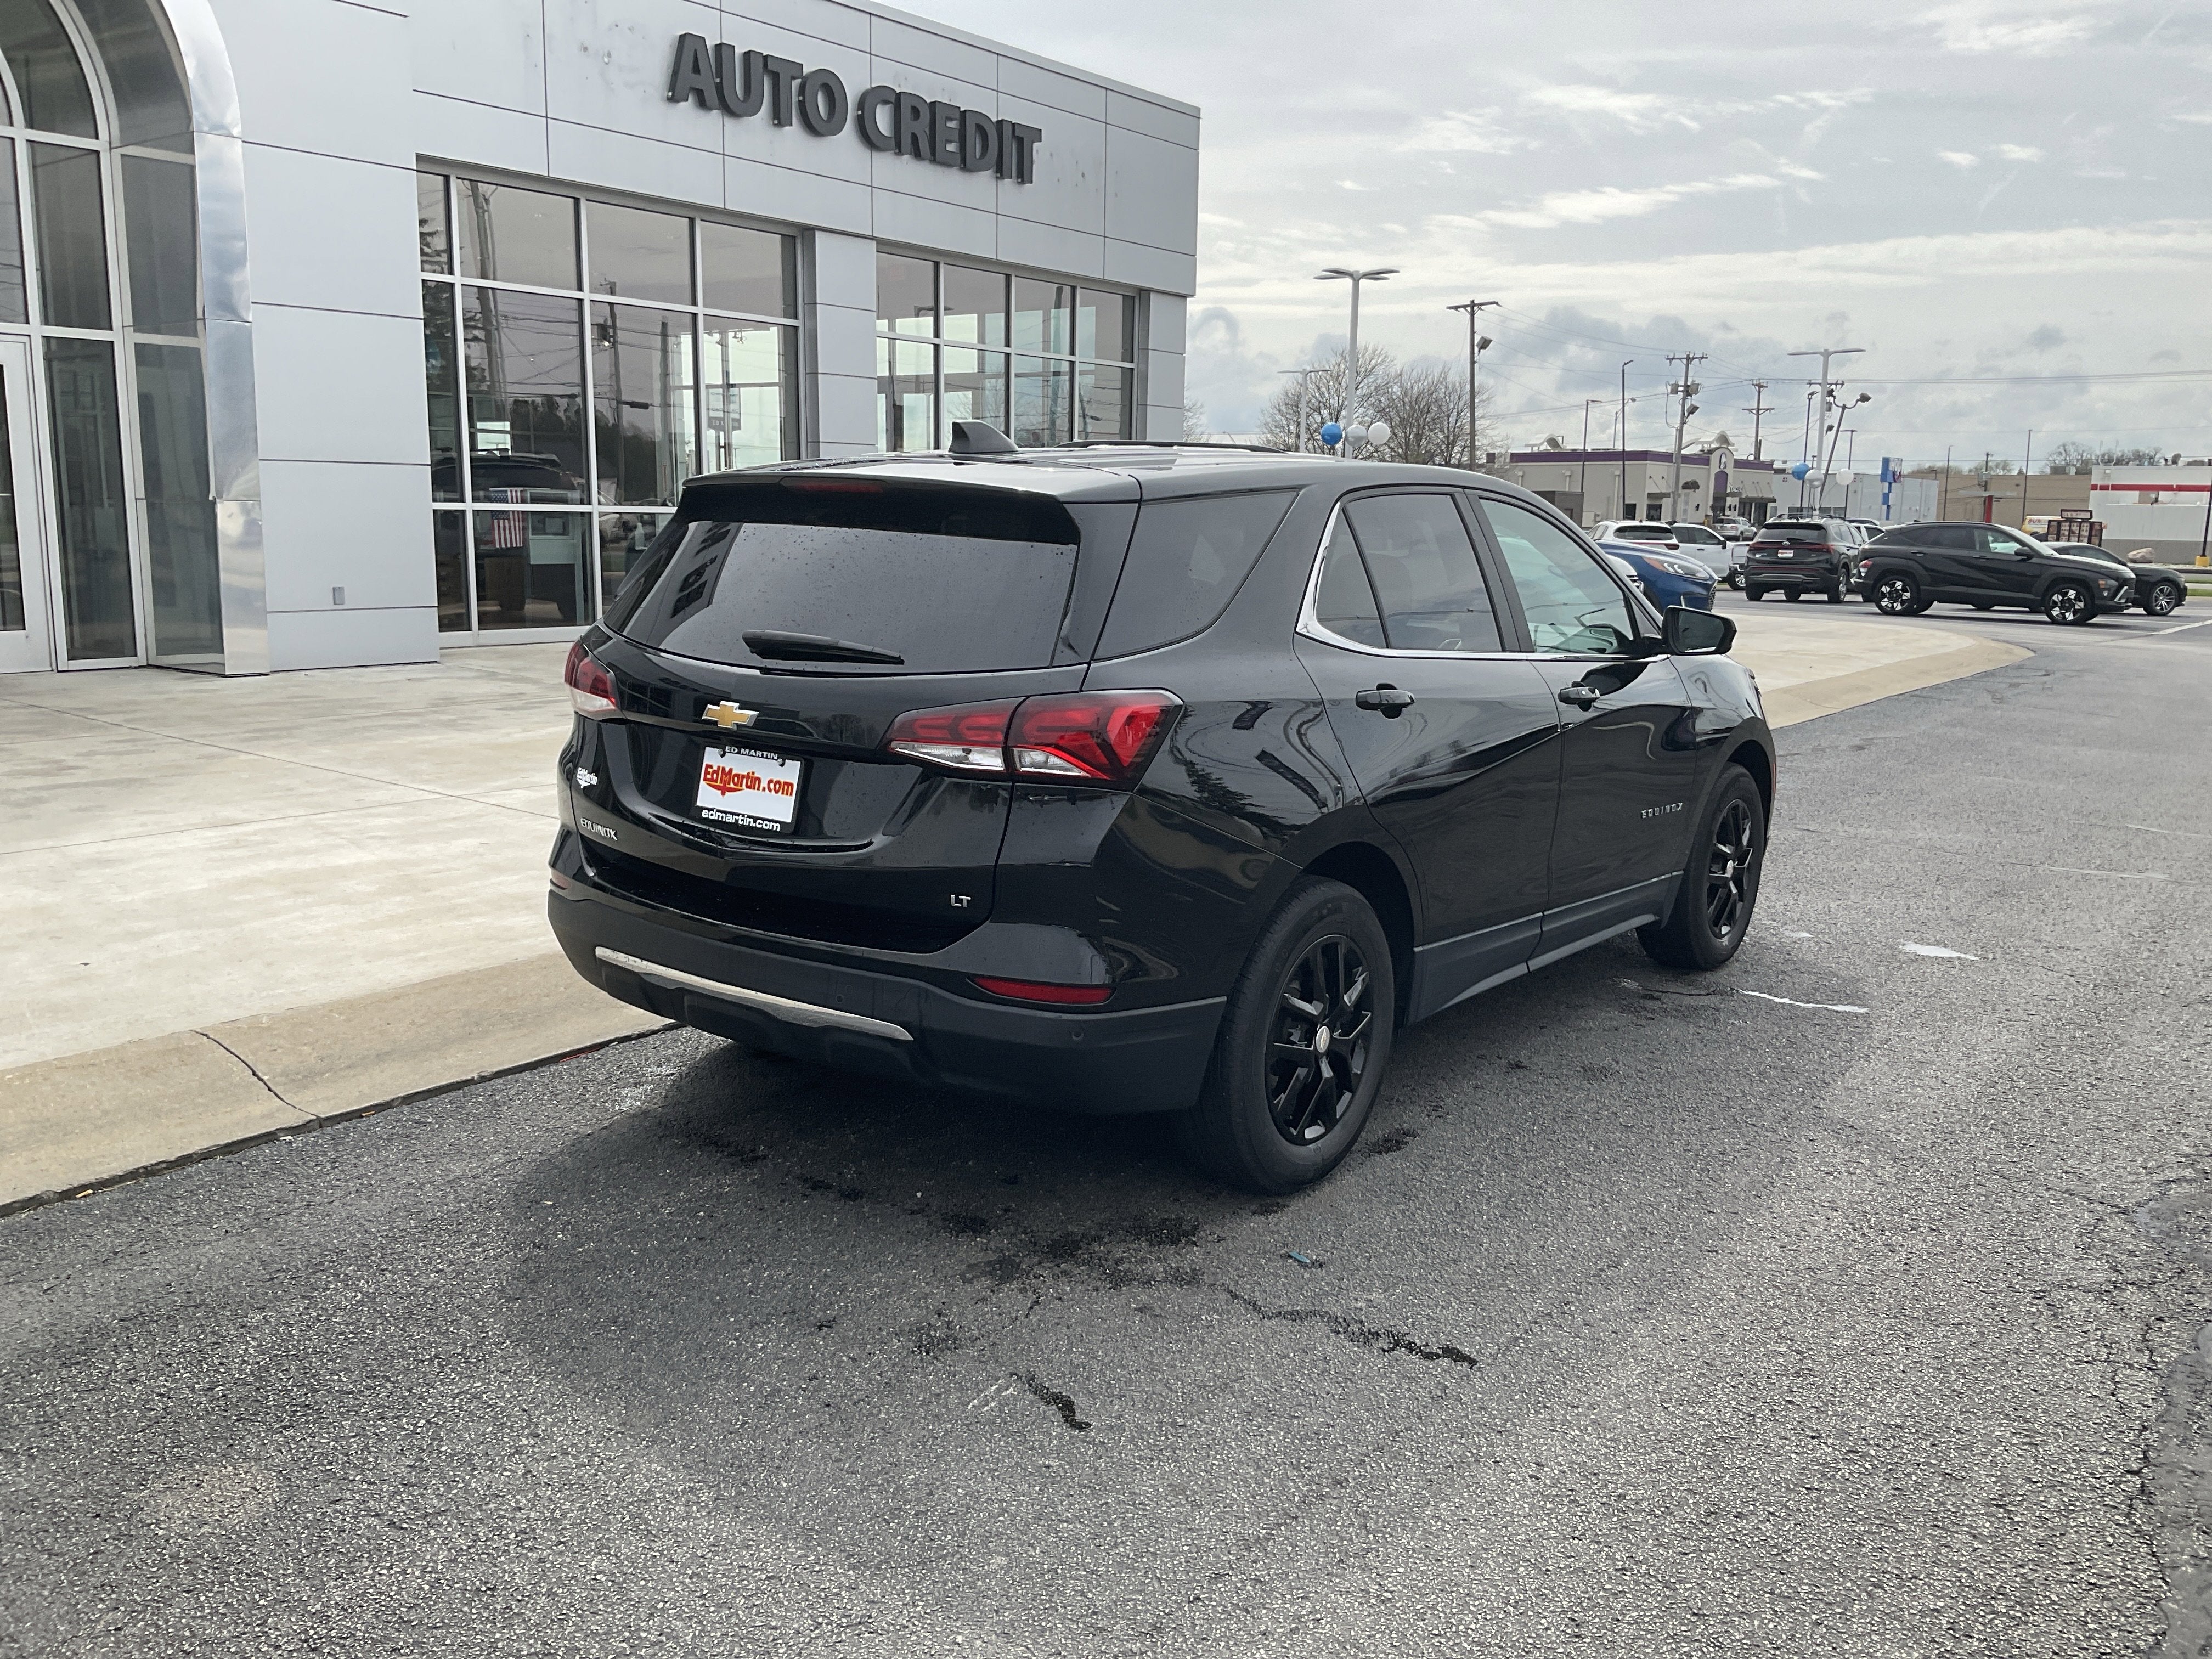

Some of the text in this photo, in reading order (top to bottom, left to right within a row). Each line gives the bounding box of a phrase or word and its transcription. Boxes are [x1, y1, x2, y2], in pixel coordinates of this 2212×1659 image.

[667, 32, 1042, 184] AUTO CREDIT
[740, 748, 778, 760] MARTIN
[703, 763, 794, 797] EdMartin.com
[702, 809, 781, 832] edmartin.com
[1641, 802, 1683, 819] EQUINOX
[580, 817, 618, 841] EQUINOX
[951, 894, 972, 908] LT
